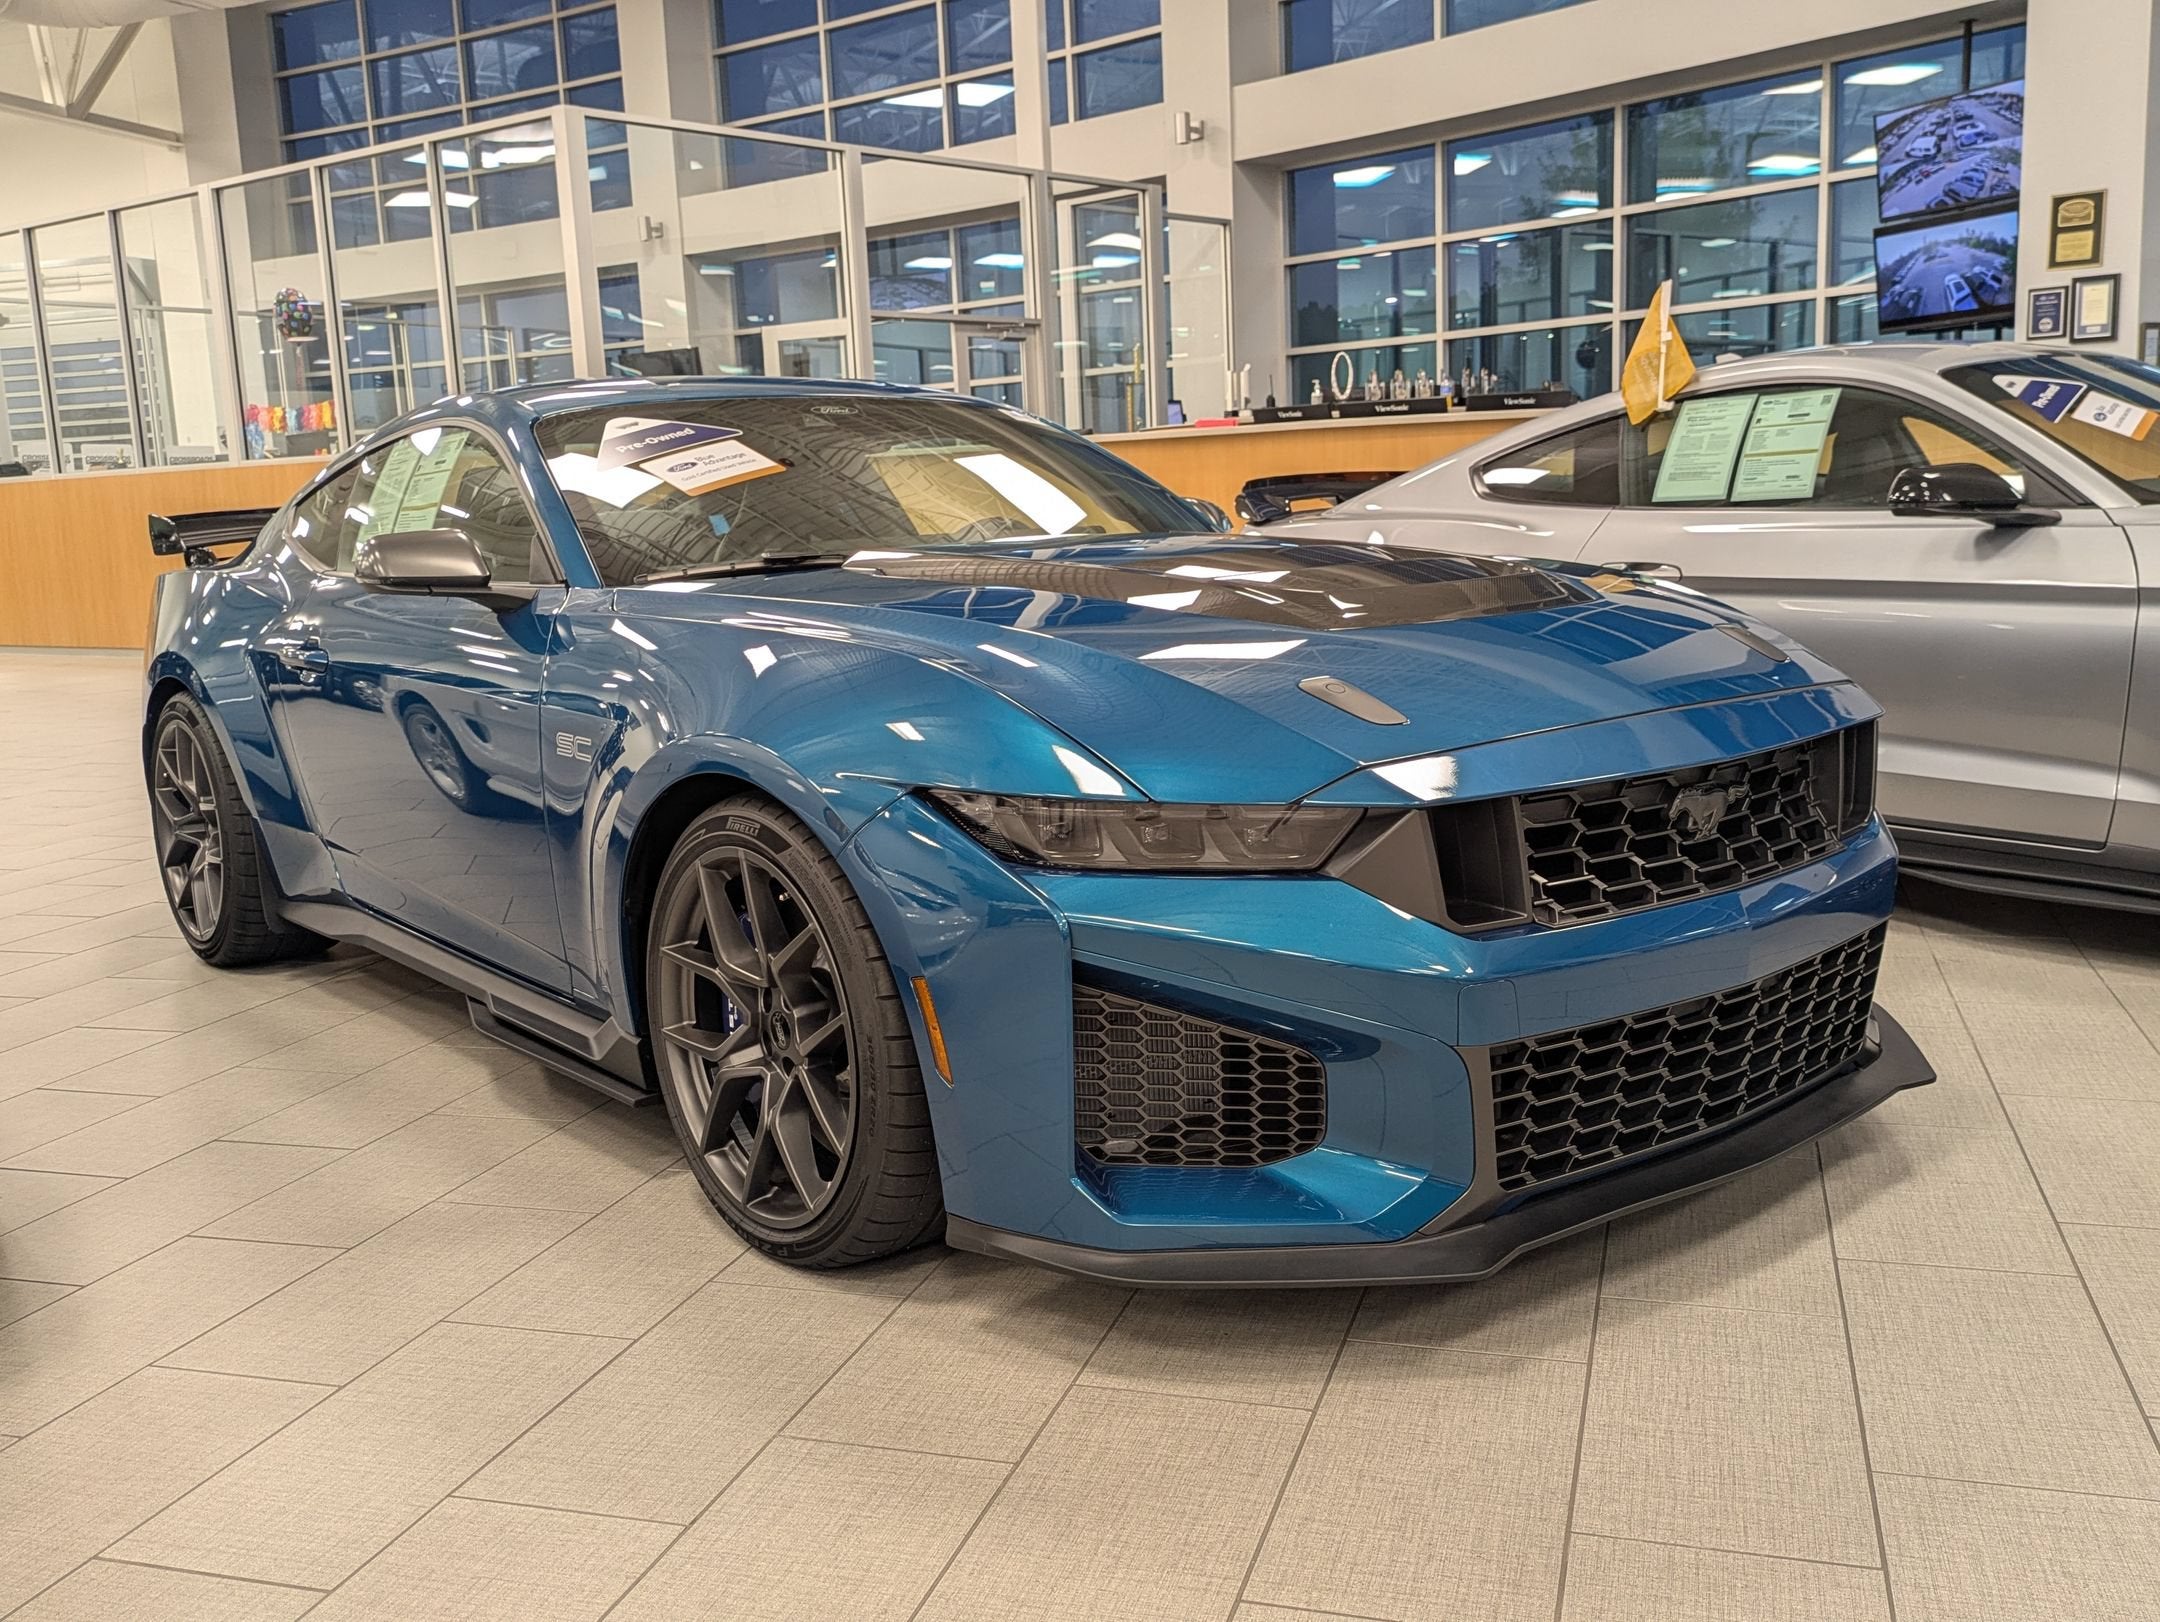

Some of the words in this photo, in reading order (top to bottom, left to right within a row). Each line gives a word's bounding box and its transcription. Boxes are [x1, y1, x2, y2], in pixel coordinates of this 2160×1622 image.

[1374, 404, 1409, 413] ViewSonic
[1503, 397, 1536, 405] ViewSonic
[615, 427, 696, 453] Pre-Owned
[702, 452, 746, 466] Advantage
[556, 731, 592, 763] SC
[725, 816, 761, 837] PIRELLI
